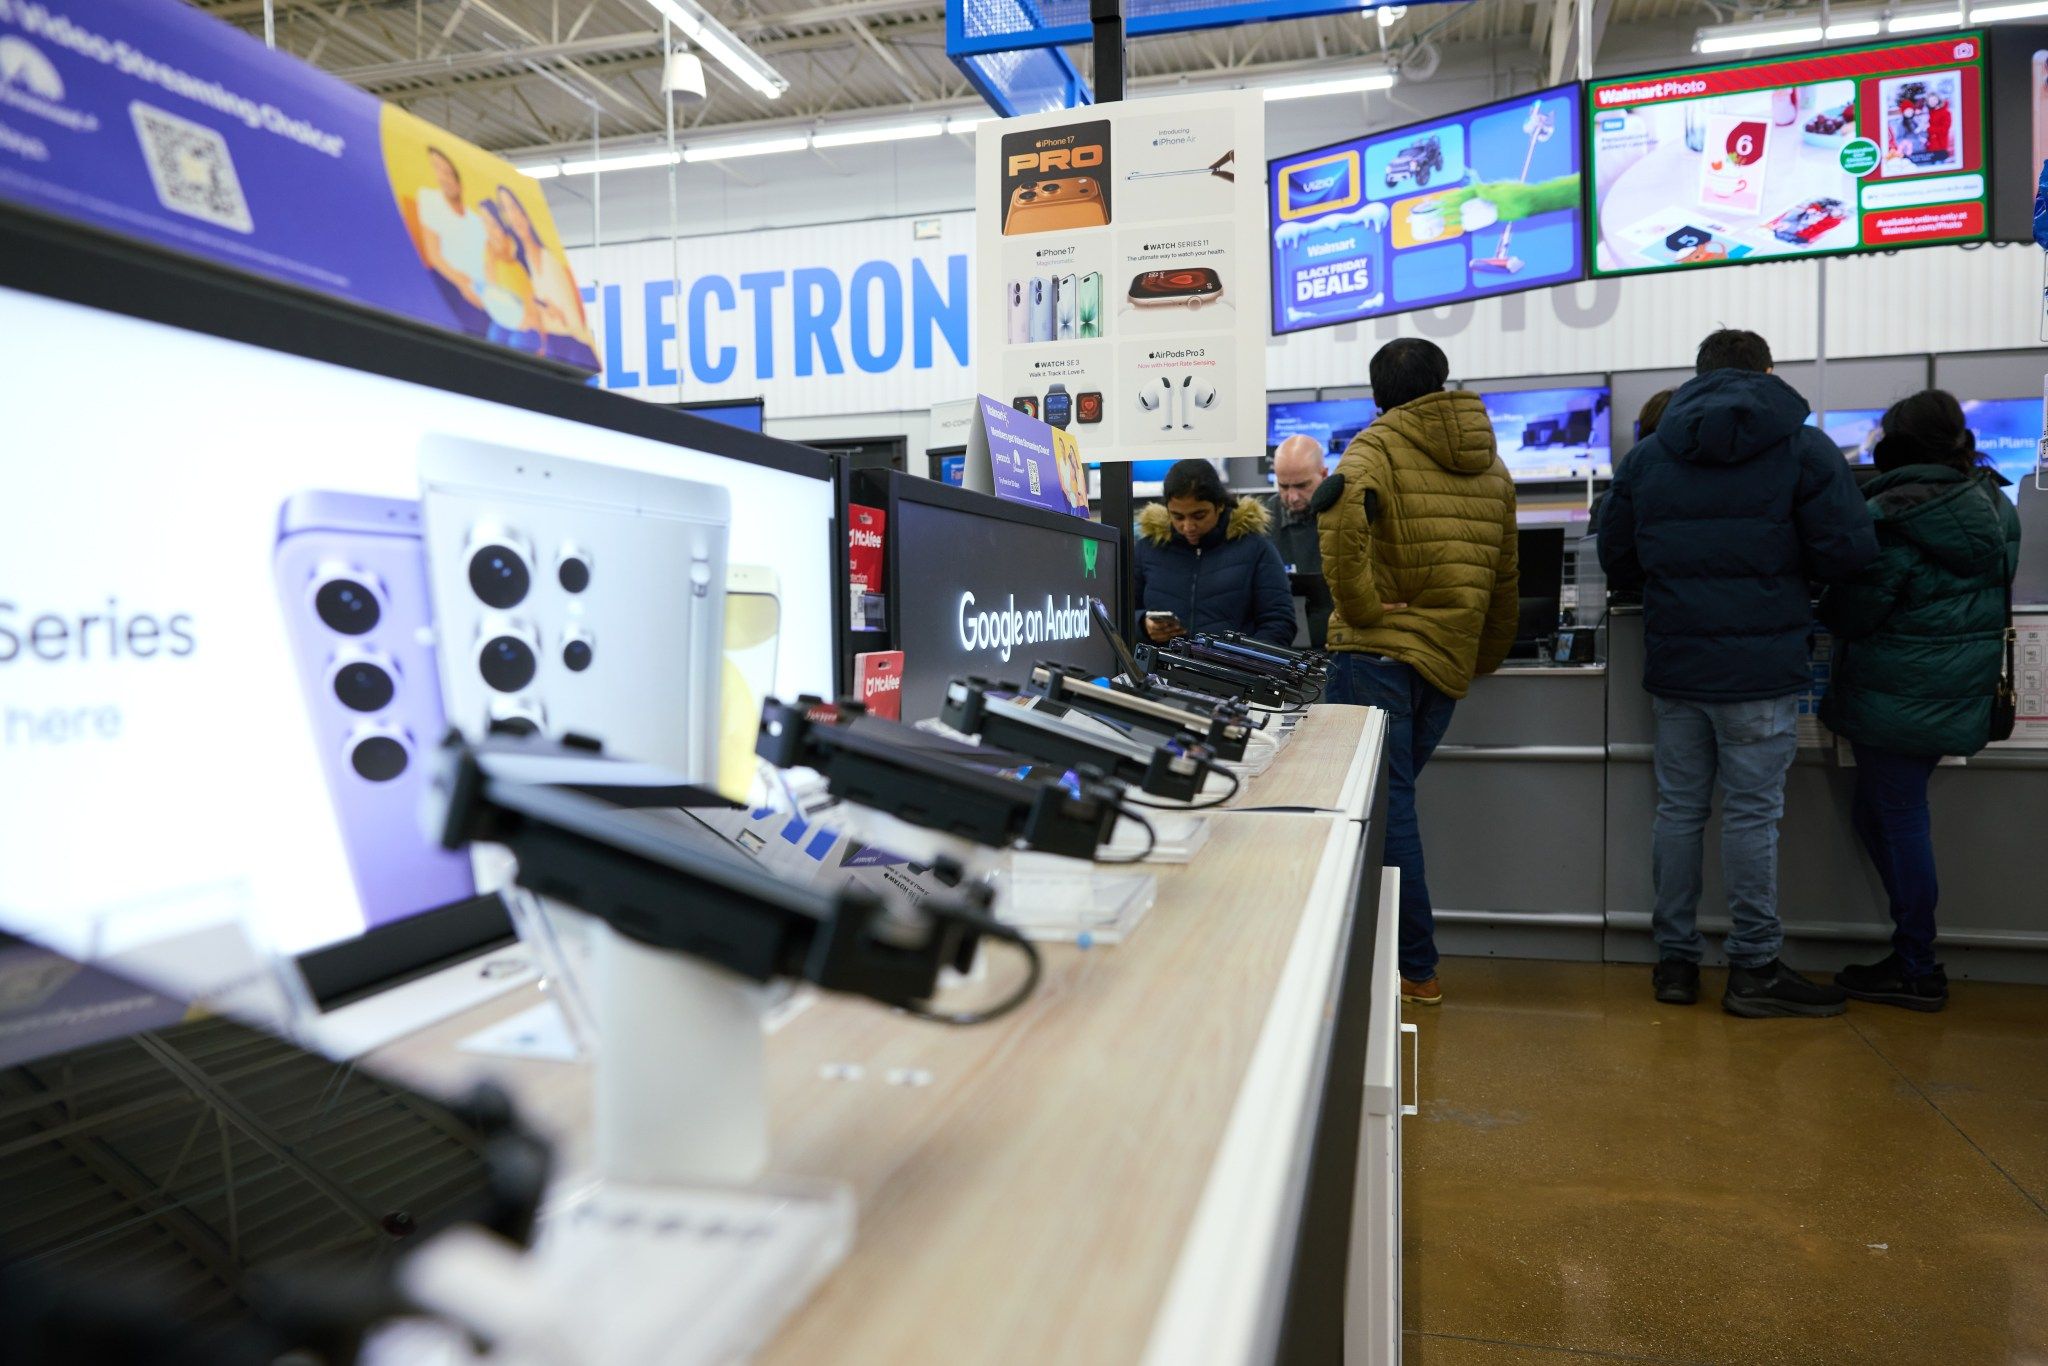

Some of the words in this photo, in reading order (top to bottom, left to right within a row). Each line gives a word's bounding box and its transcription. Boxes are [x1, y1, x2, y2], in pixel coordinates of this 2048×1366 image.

[112, 39, 263, 129] Streaming
[1599, 84, 1664, 104] Walmart
[1663, 80, 1706, 97] Photo
[1041, 138, 1067, 147] iPhone
[1067, 136, 1075, 144] 17
[1158, 128, 1190, 136] Introducing
[1159, 137, 1186, 146] iPhone
[1735, 135, 1753, 156] 6
[1008, 144, 1103, 177] PRO
[1042, 248, 1067, 257] iPhone
[1067, 246, 1075, 254] 17
[1138, 253, 1159, 261] ultimate
[1160, 251, 1171, 260] way
[1177, 249, 1195, 258] watch
[1195, 249, 1207, 257] your
[1150, 242, 1176, 251] WATCH
[1177, 240, 1202, 249] SERIES
[1307, 237, 1356, 257] Walmart
[1296, 264, 1330, 282] BLACK
[1330, 257, 1368, 277] FRIDAY
[1296, 269, 1369, 302] DEALS
[579, 254, 969, 389] LECTRON
[1155, 350, 1185, 359] AirPods
[1185, 349, 1199, 357] Pro
[1199, 348, 1205, 357] 3
[1040, 360, 1065, 368] WATCH
[1066, 359, 1075, 367] SE
[1067, 368, 1079, 376] Love
[1999, 436, 2036, 449] Plans
[855, 529, 882, 548] McAfee
[959, 591, 1023, 663] Google
[1026, 604, 1044, 643] on
[1046, 594, 1090, 641] Android
[873, 674, 900, 693] McAfee
